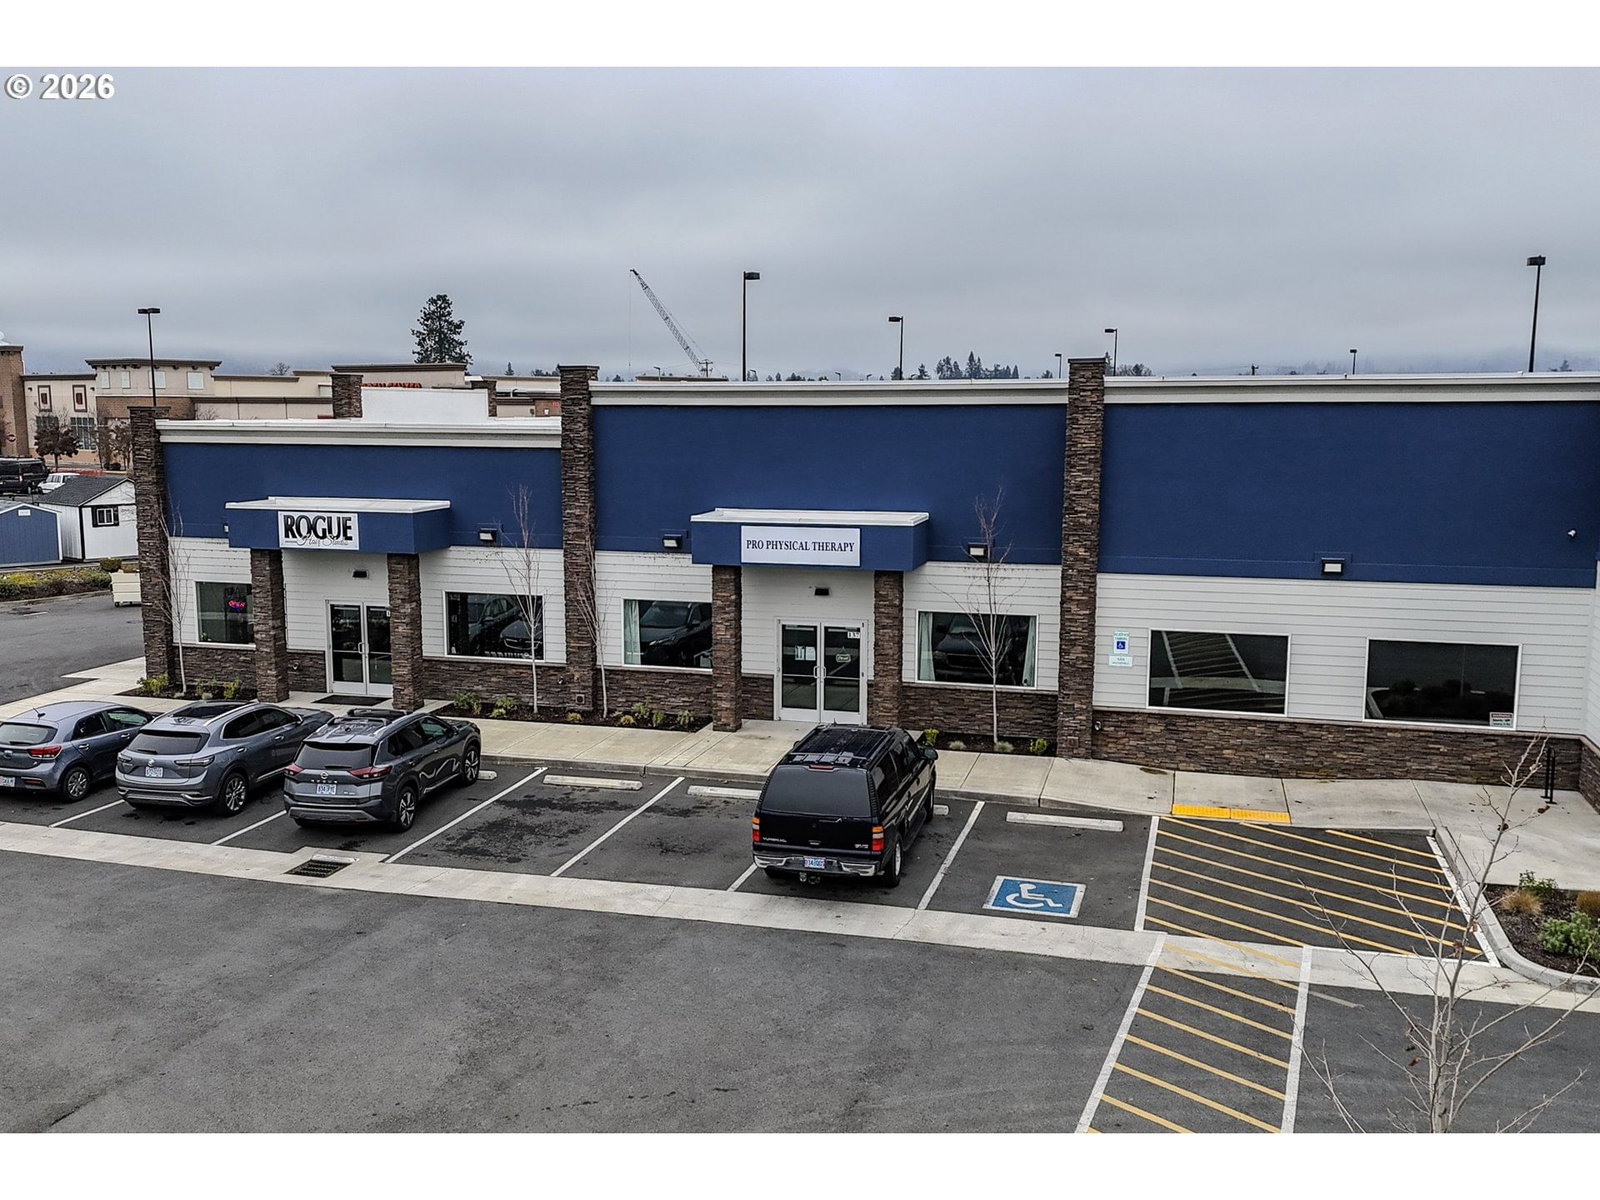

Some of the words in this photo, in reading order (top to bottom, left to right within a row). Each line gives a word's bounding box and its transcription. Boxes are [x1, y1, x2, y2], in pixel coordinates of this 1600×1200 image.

[283, 514, 353, 541] ROGUE
[746, 539, 764, 549] PRO
[766, 540, 810, 551] PHYSICAL
[812, 541, 855, 552] THERAPY
